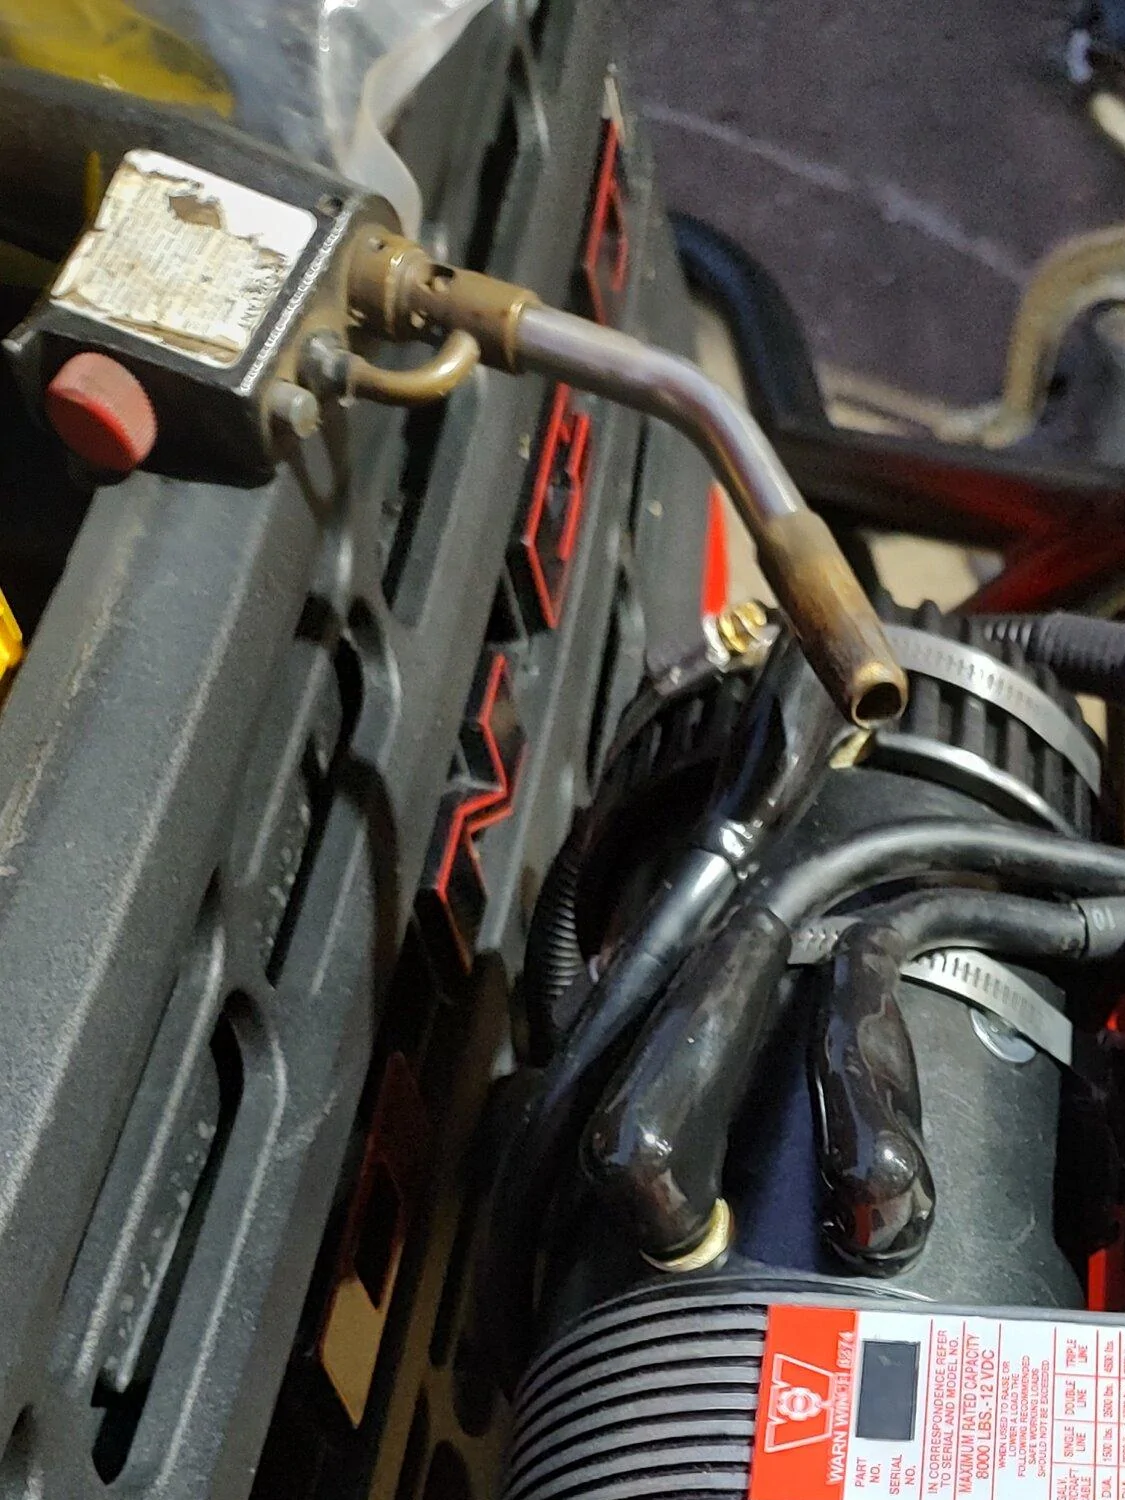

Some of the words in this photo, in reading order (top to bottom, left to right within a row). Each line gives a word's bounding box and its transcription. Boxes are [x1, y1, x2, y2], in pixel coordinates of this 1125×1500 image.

[936, 1330, 947, 1364] REFER
[949, 1337, 958, 1356] NO.
[1066, 1339, 1076, 1367] TRIPLE
[1077, 1346, 1088, 1363] LINE
[1103, 1340, 1114, 1352] lbs.
[965, 1334, 980, 1390] CAPACITY
[981, 1349, 994, 1379] VDC
[1002, 1361, 1010, 1373] OR
[947, 1359, 957, 1398] MODEL
[1001, 1376, 1010, 1400] RAISE
[1011, 1373, 1019, 1389] THE
[1020, 1355, 1030, 1422] RECOMMENDED
[1031, 1369, 1039, 1397] LOADS
[1102, 1383, 1113, 1396] lbs.
[833, 1372, 851, 1426] WINCH
[1001, 1402, 1008, 1414] TO
[1011, 1392, 1019, 1415] LOAD
[1064, 1380, 1076, 1415] DOUBLE
[1077, 1390, 1086, 1408] LINE
[929, 1369, 945, 1479] CORRESPONDENCE
[945, 1402, 955, 1425] AND
[963, 1394, 977, 1431] RATED
[1029, 1400, 1038, 1440] WORKING
[1040, 1407, 1048, 1418] BE
[1000, 1417, 1008, 1439] USED
[1039, 1421, 1047, 1438] NOT
[1102, 1428, 1113, 1440] lbs.
[942, 1430, 954, 1469] SERIAL
[1009, 1426, 1017, 1457] LOWER
[1018, 1426, 1028, 1477] FOLLOWING
[1028, 1444, 1036, 1464] SAFE
[1064, 1426, 1074, 1457] SINGLE
[1076, 1433, 1086, 1452] LINE
[1102, 1443, 1113, 1462] 1500
[829, 1432, 848, 1483] WARN
[959, 1435, 974, 1493] MAXIMUM
[976, 1445, 990, 1479] 8000
[998, 1442, 1007, 1468] WHEN
[1037, 1441, 1047, 1477] SHOULD
[854, 1457, 866, 1487] PART
[870, 1464, 881, 1483] NO.
[890, 1454, 902, 1495] SERIAL
[905, 1466, 916, 1485] NO.
[941, 1473, 951, 1487] TO
[928, 1483, 938, 1494] IN
[1101, 1477, 1112, 1498] DIA.
